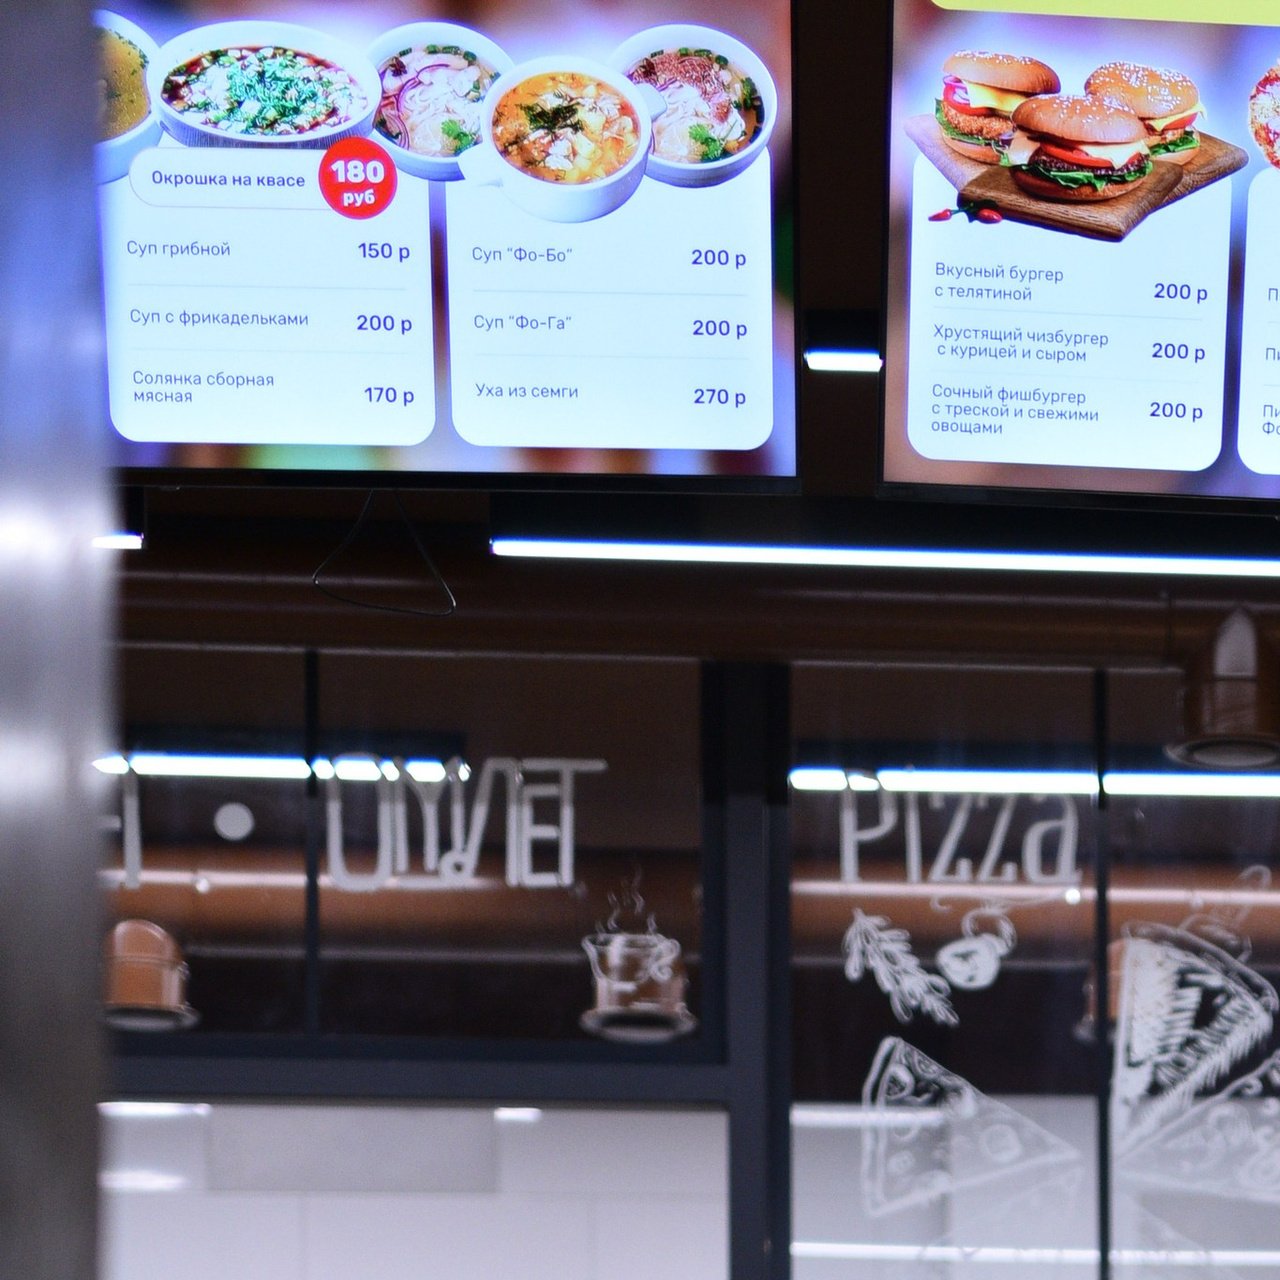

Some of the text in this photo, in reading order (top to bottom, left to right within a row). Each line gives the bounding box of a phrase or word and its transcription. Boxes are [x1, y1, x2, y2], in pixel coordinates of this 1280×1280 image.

[151, 169, 306, 189] Окрошка на квасе
[331, 160, 384, 184] 180
[343, 188, 375, 206] руб
[126, 239, 231, 259] Суп грибной
[357, 241, 411, 264] 150 р
[690, 248, 747, 271] 200 р
[935, 261, 1064, 285] Вкусный бургер
[934, 285, 1032, 301] с телятиной
[1153, 282, 1209, 305] 200 р
[129, 308, 309, 327] Суп с фрикадельками
[356, 314, 413, 336] 200 р
[692, 319, 748, 341] 200 р
[933, 323, 1109, 349] Хрустящий чизбургер
[937, 344, 1087, 364] с курицей и сыром
[1151, 342, 1206, 364] 200 р
[132, 370, 275, 390] Солянка сборная
[475, 382, 579, 399] Уха из семги
[133, 390, 193, 403] мясная
[363, 386, 415, 408] 170 р
[693, 388, 747, 409] 270 р
[932, 383, 1087, 407] Сочный фишбургер
[931, 403, 1099, 422] с треской и свежими
[1149, 401, 1204, 424] 200 р
[931, 420, 1003, 436] овощами
